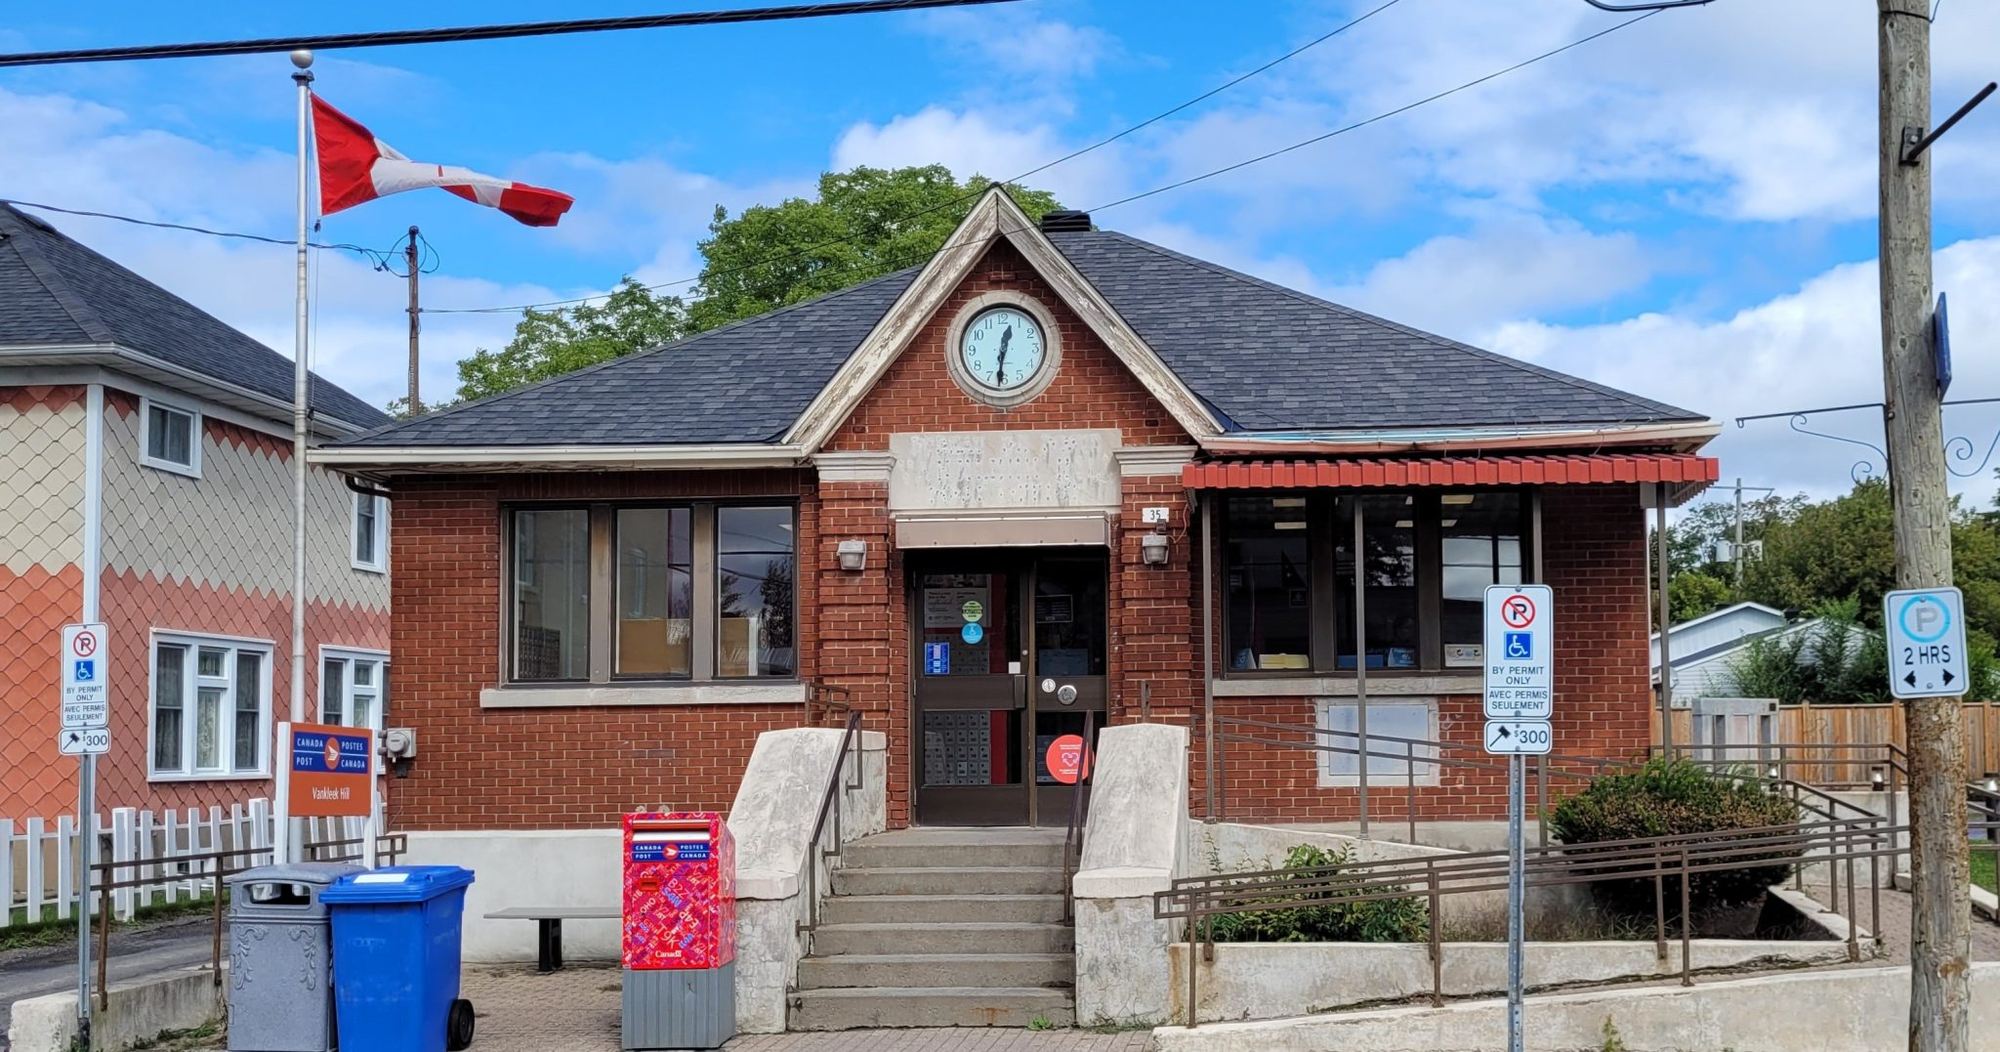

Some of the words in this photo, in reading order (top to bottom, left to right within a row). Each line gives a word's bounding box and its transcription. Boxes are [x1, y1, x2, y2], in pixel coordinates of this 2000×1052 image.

[984, 318, 992, 330] 11
[998, 313, 1008, 325] 12
[973, 329, 984, 341] 10
[1026, 328, 1034, 339] 2
[968, 344, 976, 356] 9
[1031, 343, 1040, 354] 3
[973, 360, 982, 371] 8
[1025, 358, 1033, 369] 4
[985, 371, 994, 382] 7
[1001, 374, 1009, 385] 6
[1015, 370, 1024, 381] 5
[1150, 509, 1161, 520] 35
[1916, 607, 1938, 632] P
[1904, 647, 1914, 665] 2
[1919, 645, 1951, 664] HRS
[1492, 666, 1504, 675] BY
[1509, 666, 1544, 675] PERMIT
[1506, 676, 1531, 685] ONLY
[78, 685, 102, 693] PERMIT
[1489, 690, 1512, 699] AVEC
[1515, 690, 1548, 699] PERMIS
[64, 705, 80, 713] AVEC
[83, 704, 105, 712] PERMIS
[1492, 701, 1544, 710] SEULEMENT
[66, 713, 103, 721] SEULEMENT
[1514, 730, 1548, 744] $300
[296, 738, 323, 747] CANADA
[341, 741, 363, 751] POSTES
[296, 757, 312, 766] POST
[341, 759, 365, 768] CANADA
[312, 786, 339, 800] Vankleek
[340, 787, 350, 800] Hill
[655, 950, 681, 958] Canada
